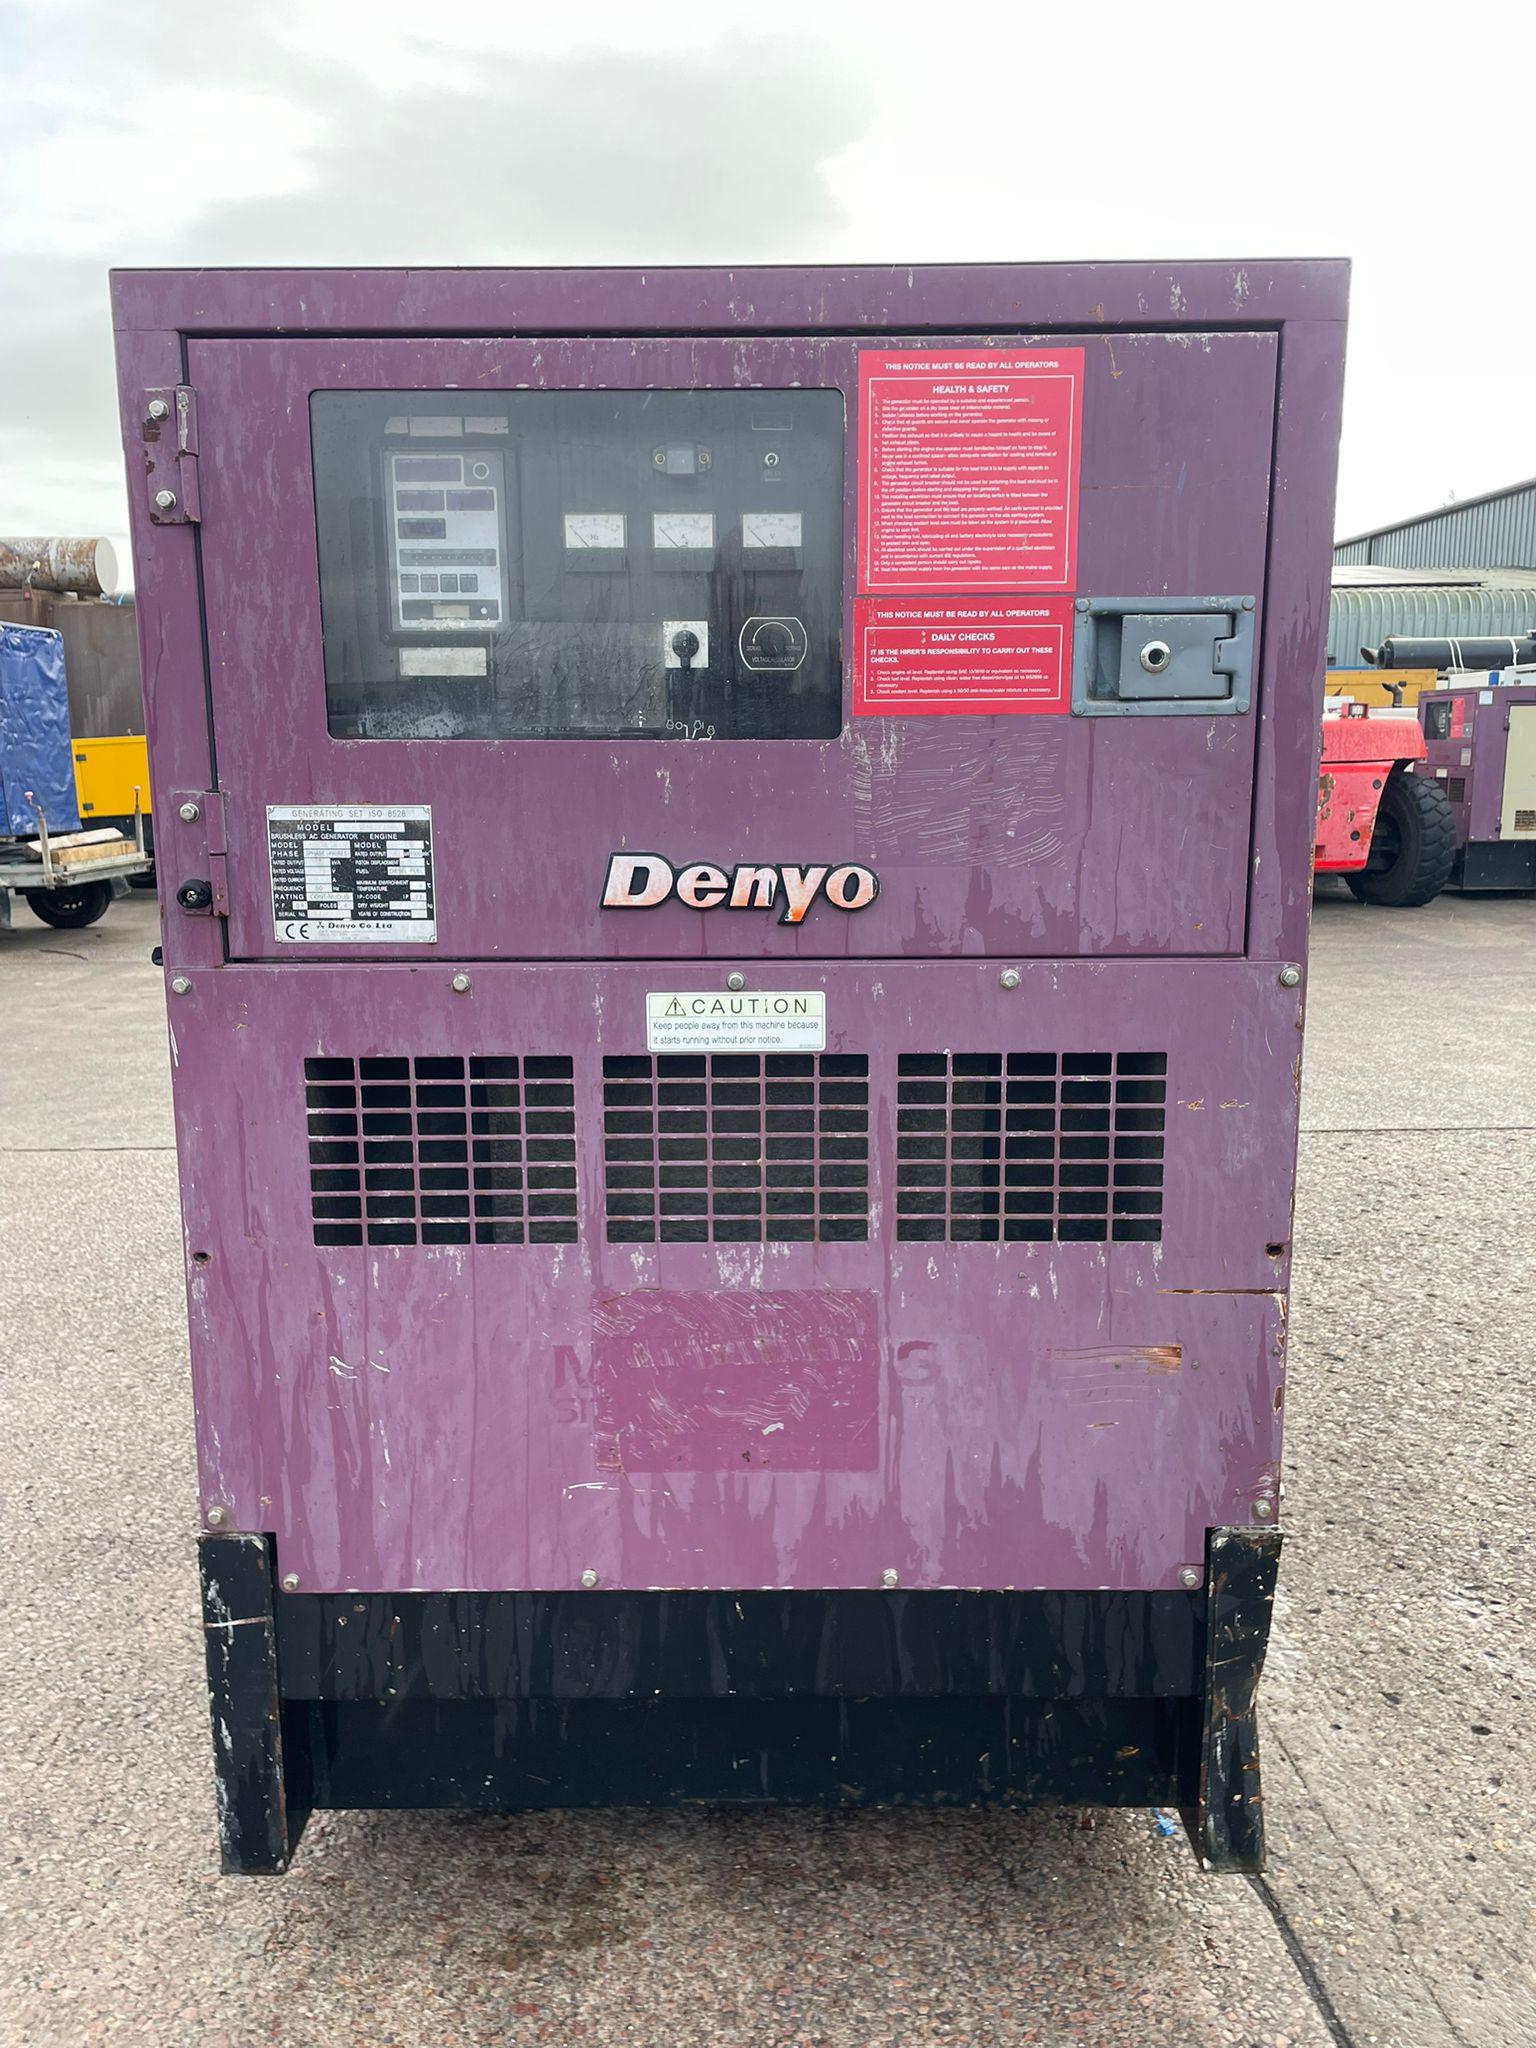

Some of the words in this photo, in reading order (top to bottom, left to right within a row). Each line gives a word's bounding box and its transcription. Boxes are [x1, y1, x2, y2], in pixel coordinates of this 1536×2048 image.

[933, 385, 966, 394] HEALTH
[968, 385, 974, 393] &
[976, 385, 1010, 393] SAFETY
[931, 633, 956, 641] DAILY
[958, 633, 995, 641] CHECKS
[601, 853, 878, 924] Denyo
[692, 998, 807, 1014] CAUTION
[653, 1022, 673, 1031] Keep
[675, 1023, 699, 1031] people
[701, 1023, 720, 1031] away
[722, 1021, 738, 1030] from
[741, 1021, 754, 1030] this
[755, 1021, 785, 1030] machine
[787, 1021, 819, 1030] because
[653, 1036, 658, 1044] it
[659, 1036, 680, 1044] starts
[683, 1036, 709, 1046] running
[711, 1036, 737, 1044] without
[739, 1035, 756, 1046] prior
[758, 1035, 782, 1044] notice.
